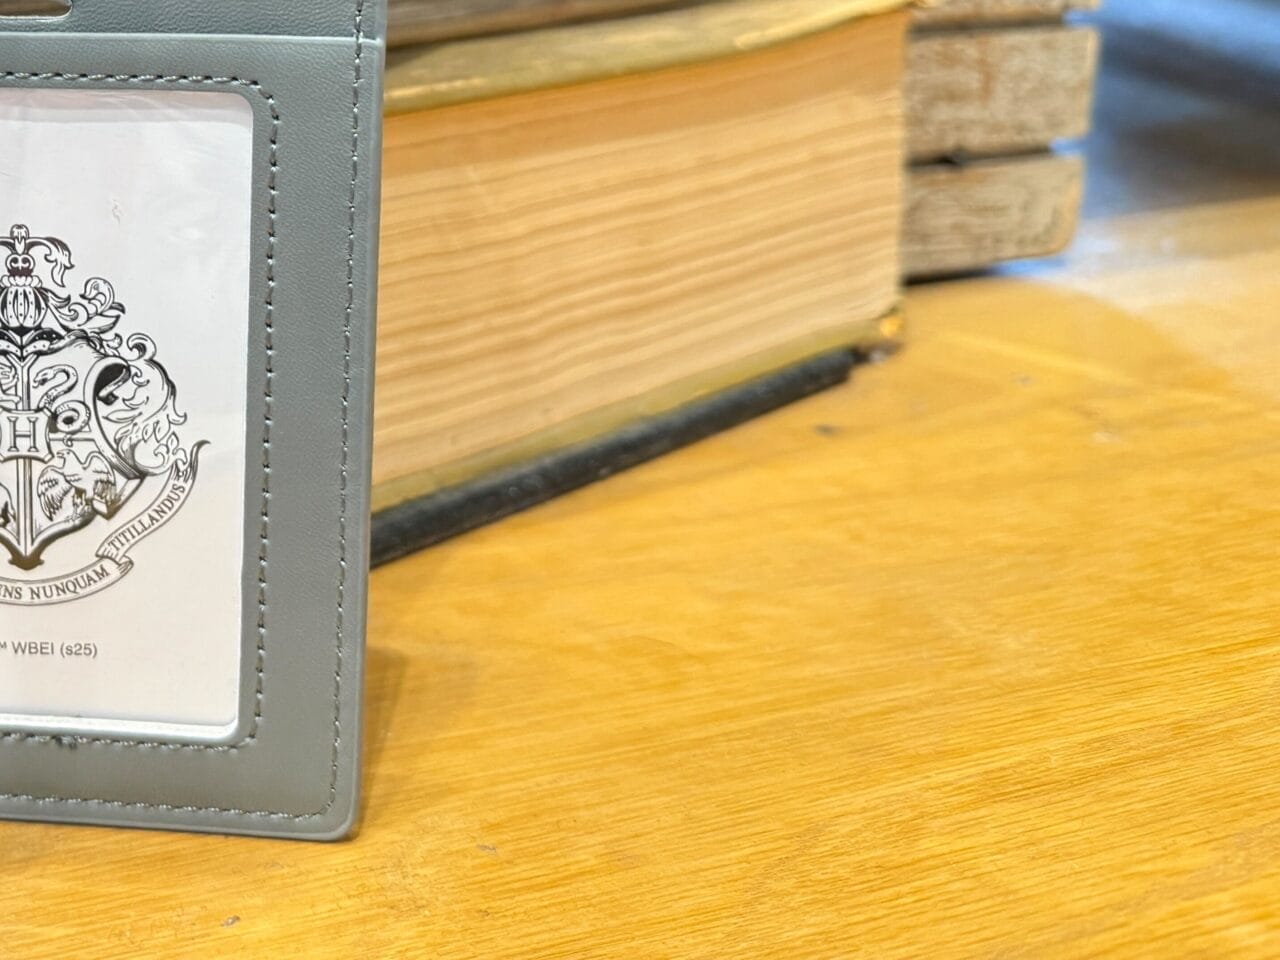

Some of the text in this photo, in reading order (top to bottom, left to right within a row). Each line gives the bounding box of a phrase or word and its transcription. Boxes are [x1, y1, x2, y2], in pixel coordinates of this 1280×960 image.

[29, 564, 111, 601] NUNQUAM
[108, 483, 186, 552] TITILLANDUS
[12, 641, 55, 656] WBEI
[60, 642, 98, 659] (s25)
